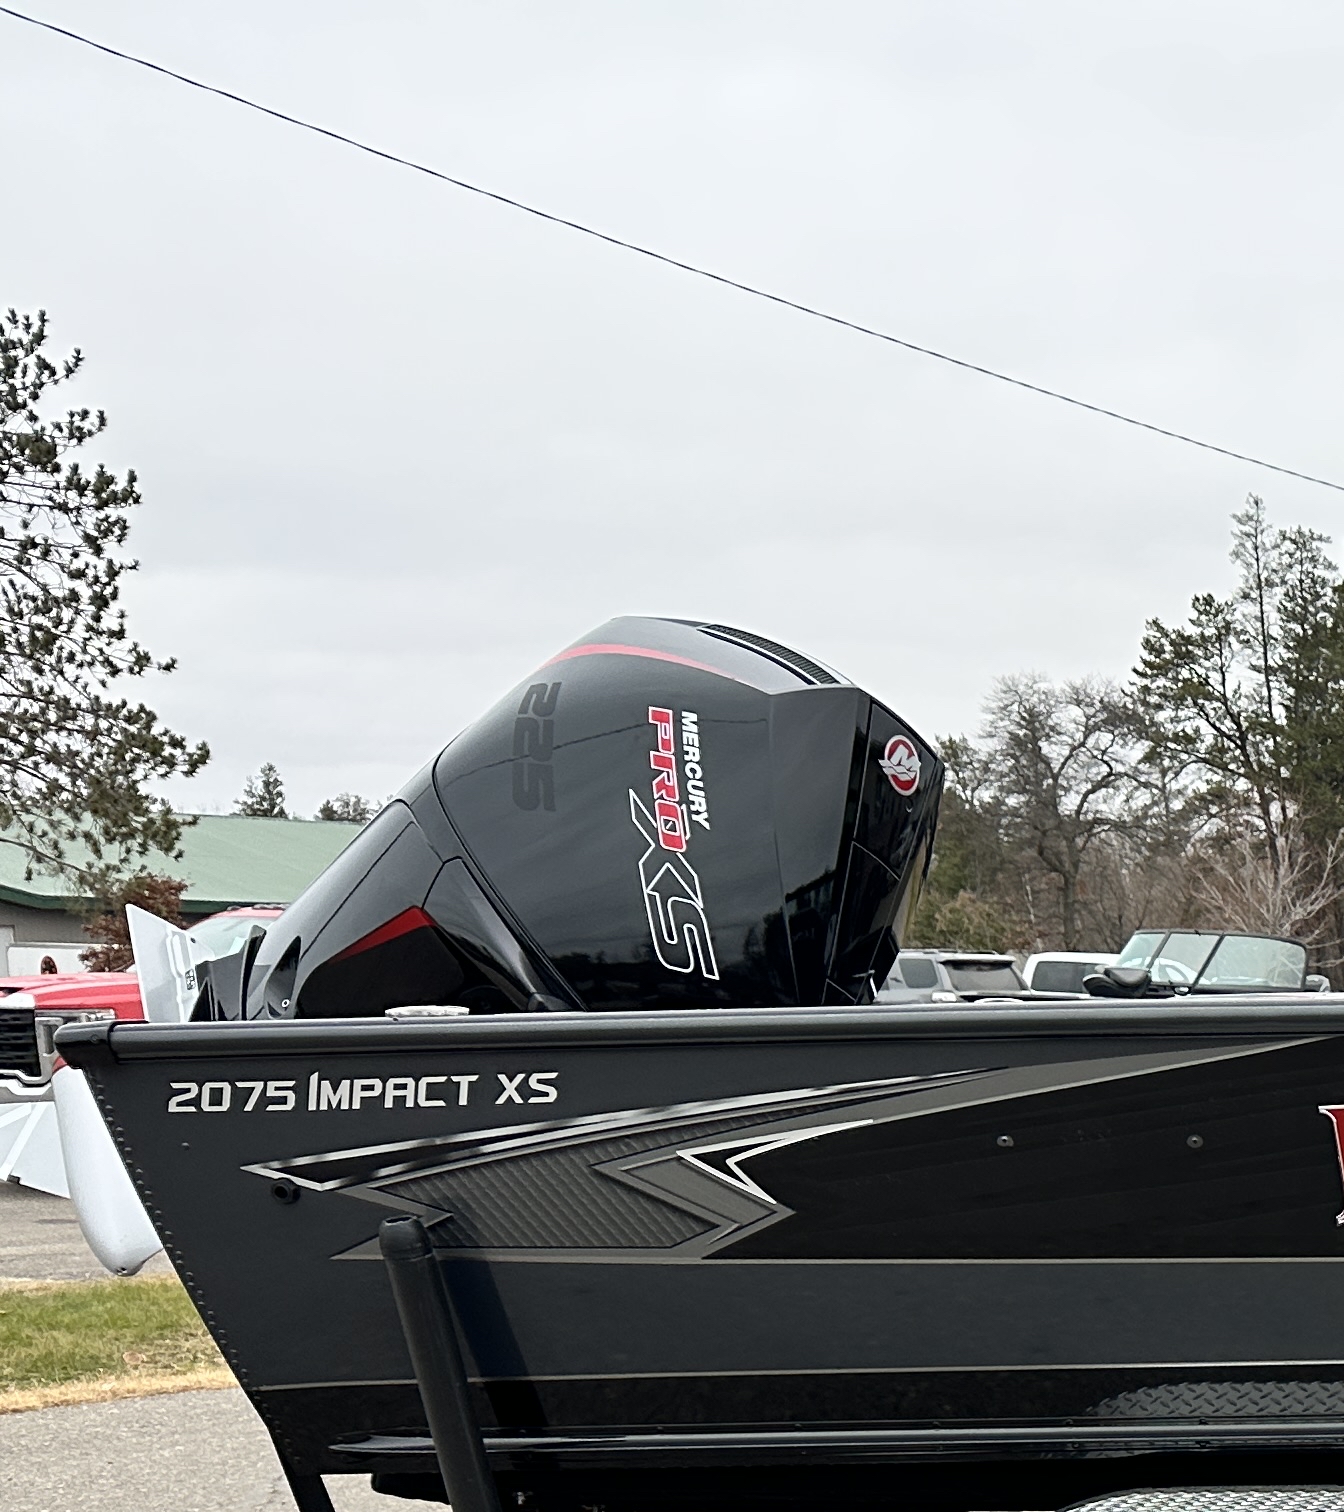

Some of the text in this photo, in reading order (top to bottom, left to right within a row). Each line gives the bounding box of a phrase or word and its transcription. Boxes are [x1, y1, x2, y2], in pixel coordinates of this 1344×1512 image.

[511, 681, 563, 812] 225
[681, 710, 710, 830] MERCURY
[628, 705, 720, 981] PRO XS
[167, 1071, 560, 1113] 2075 IMPACT XS
